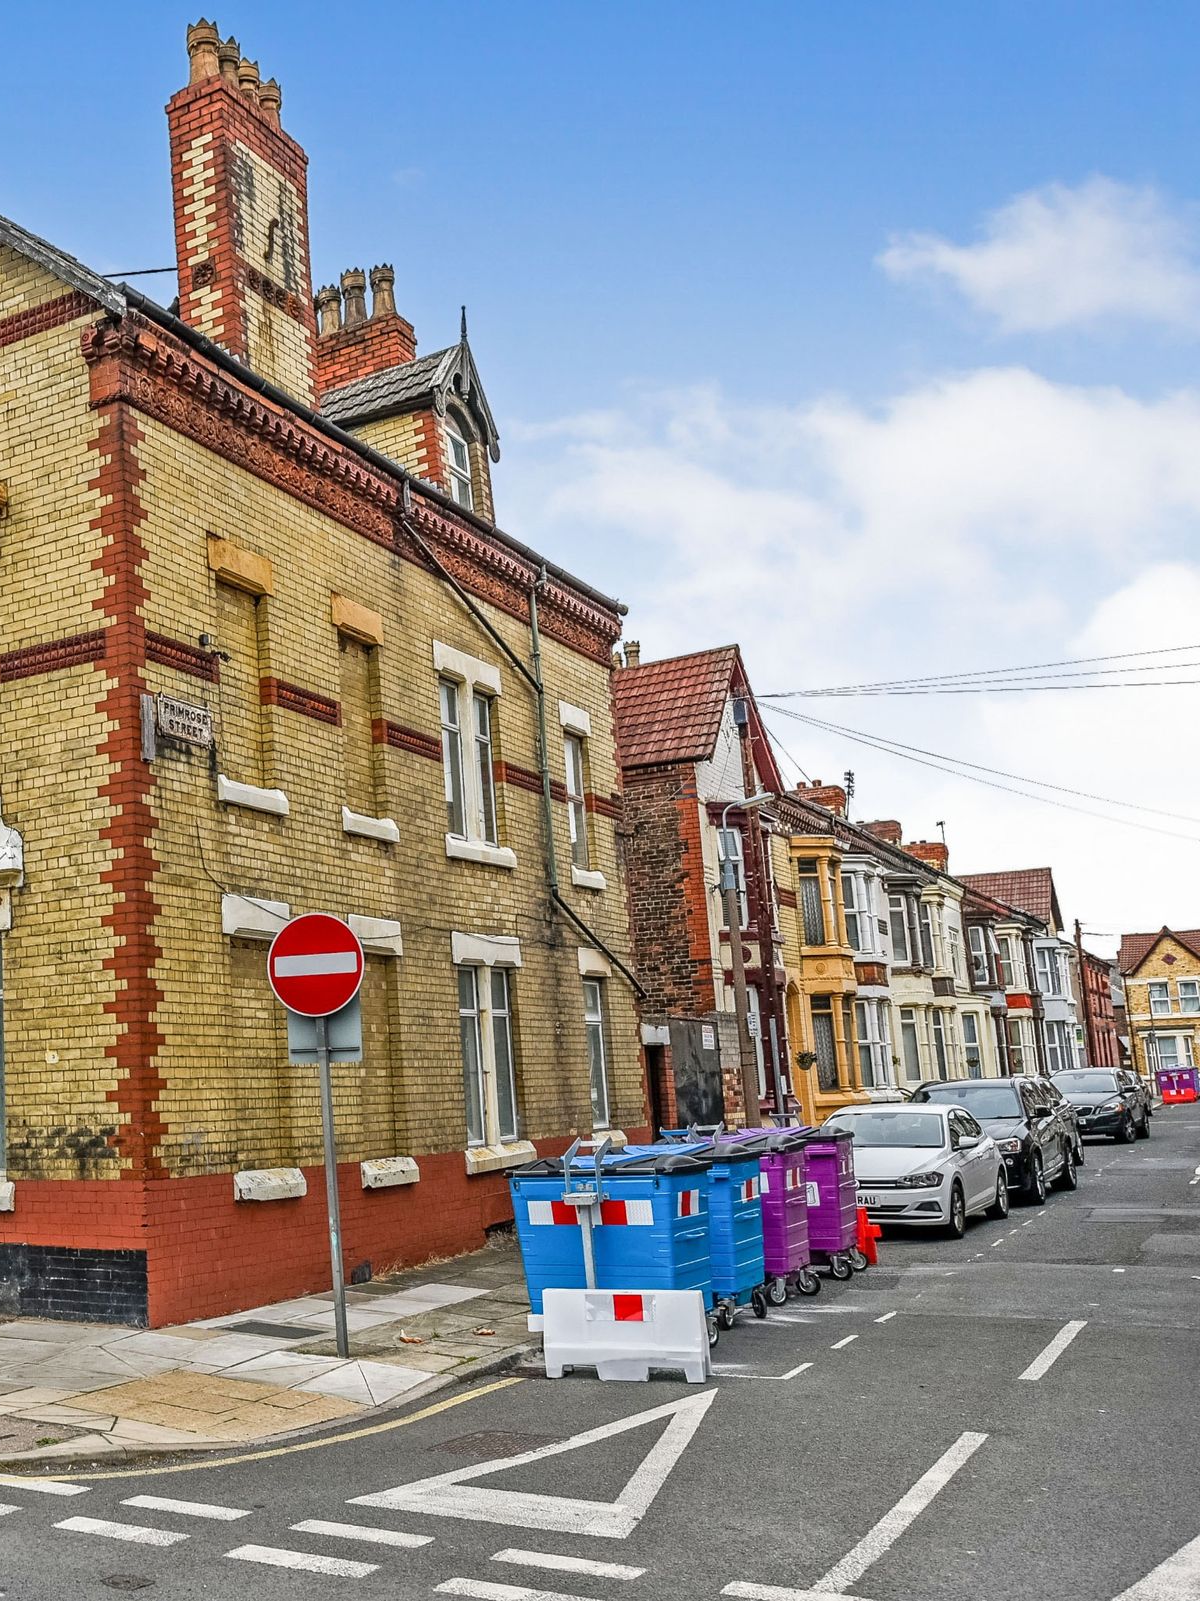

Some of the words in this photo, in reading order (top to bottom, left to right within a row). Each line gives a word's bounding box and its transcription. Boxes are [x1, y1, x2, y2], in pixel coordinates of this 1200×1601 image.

[164, 702, 208, 725] PRIMROSE
[169, 719, 203, 739] STREET
[857, 1196, 876, 1205] RAU
